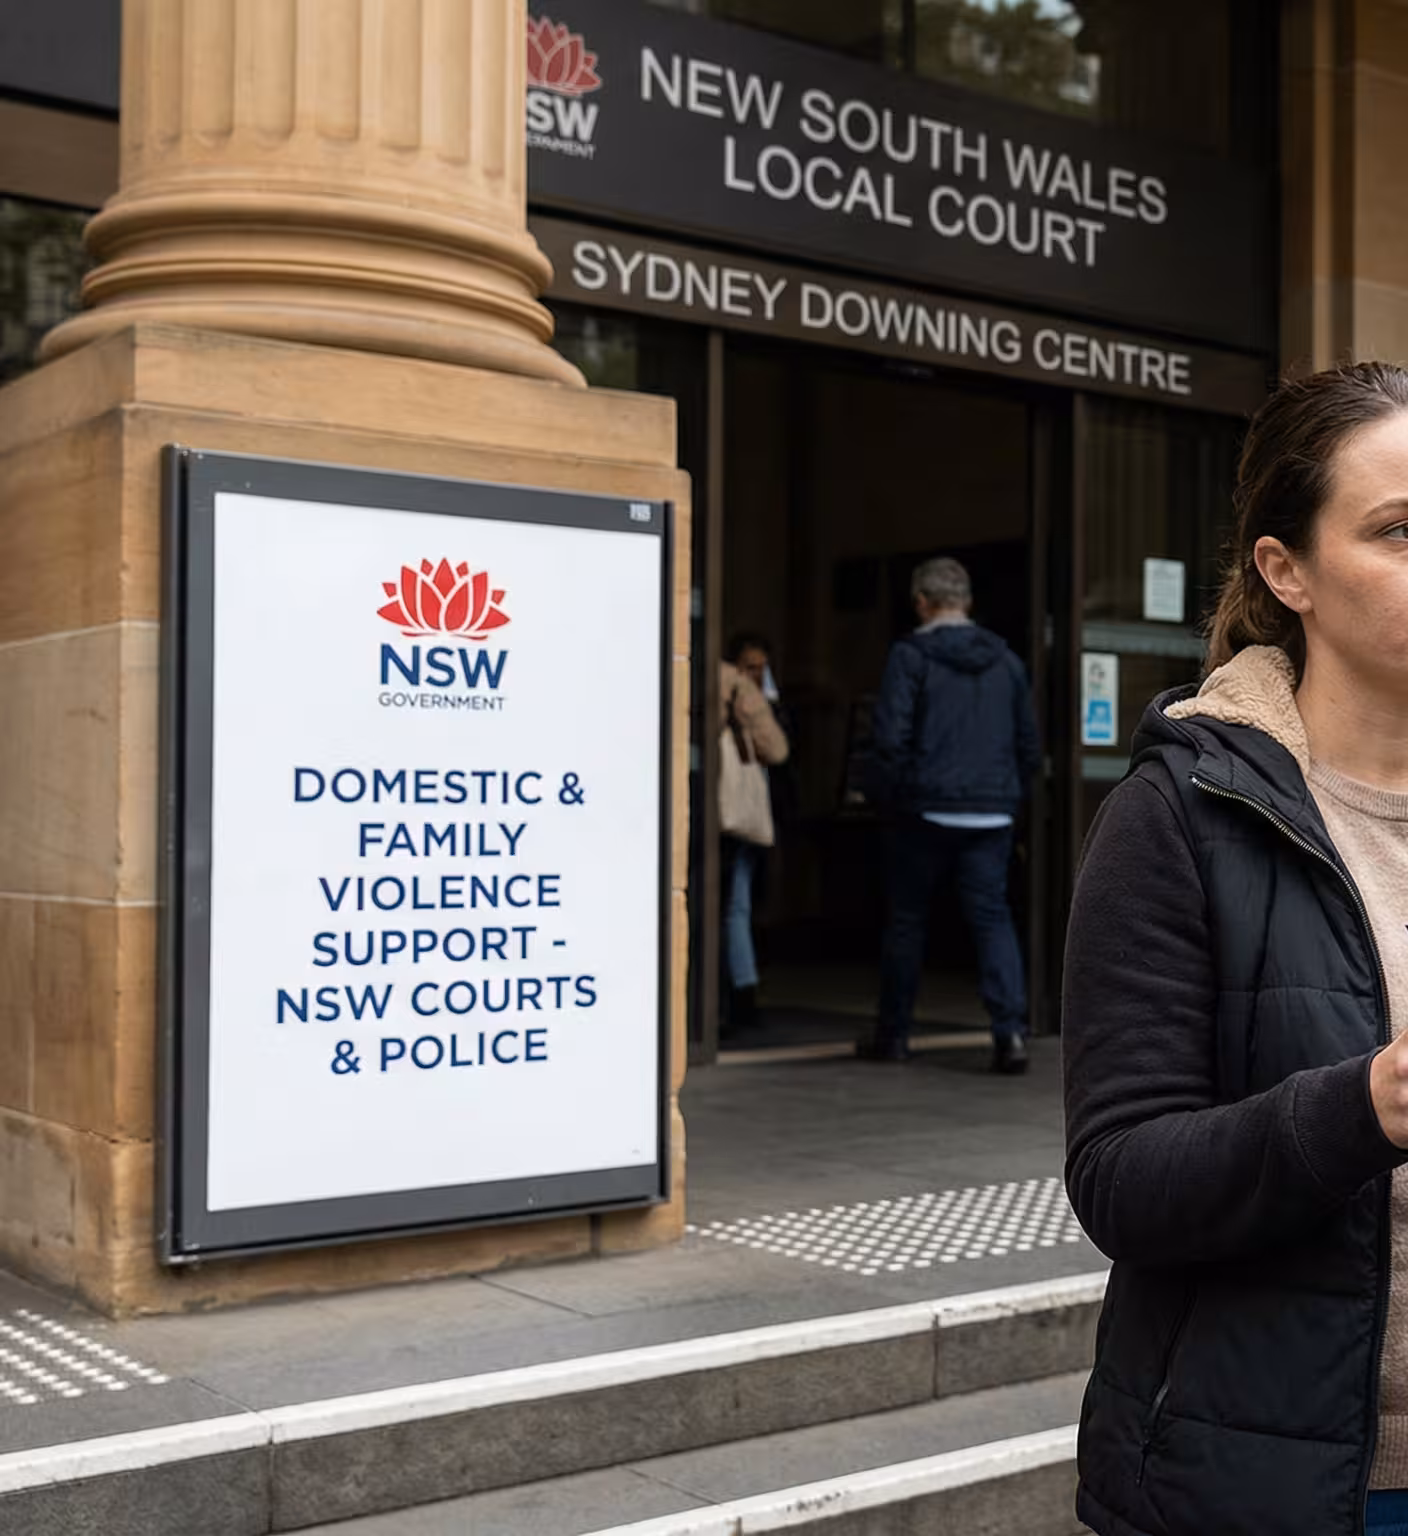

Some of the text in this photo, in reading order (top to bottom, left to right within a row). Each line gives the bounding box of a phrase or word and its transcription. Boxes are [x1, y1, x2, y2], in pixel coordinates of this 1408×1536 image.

[527, 91, 598, 142] SW
[641, 47, 1167, 224] NEW SOUTH WALES
[724, 136, 1105, 267] LOCAL COURT
[572, 241, 1191, 394] SYDNEY DOWNING CENTRE
[380, 643, 508, 689] NSW
[379, 692, 505, 711] GOVERNMENT
[294, 767, 585, 806] DOMESTIC &
[359, 822, 527, 858] FAMILY
[318, 874, 561, 912] VIOLENCE
[312, 926, 537, 968] SUPPORT
[276, 975, 598, 1024] NSW COURTS
[330, 1028, 548, 1075] & POLICE
